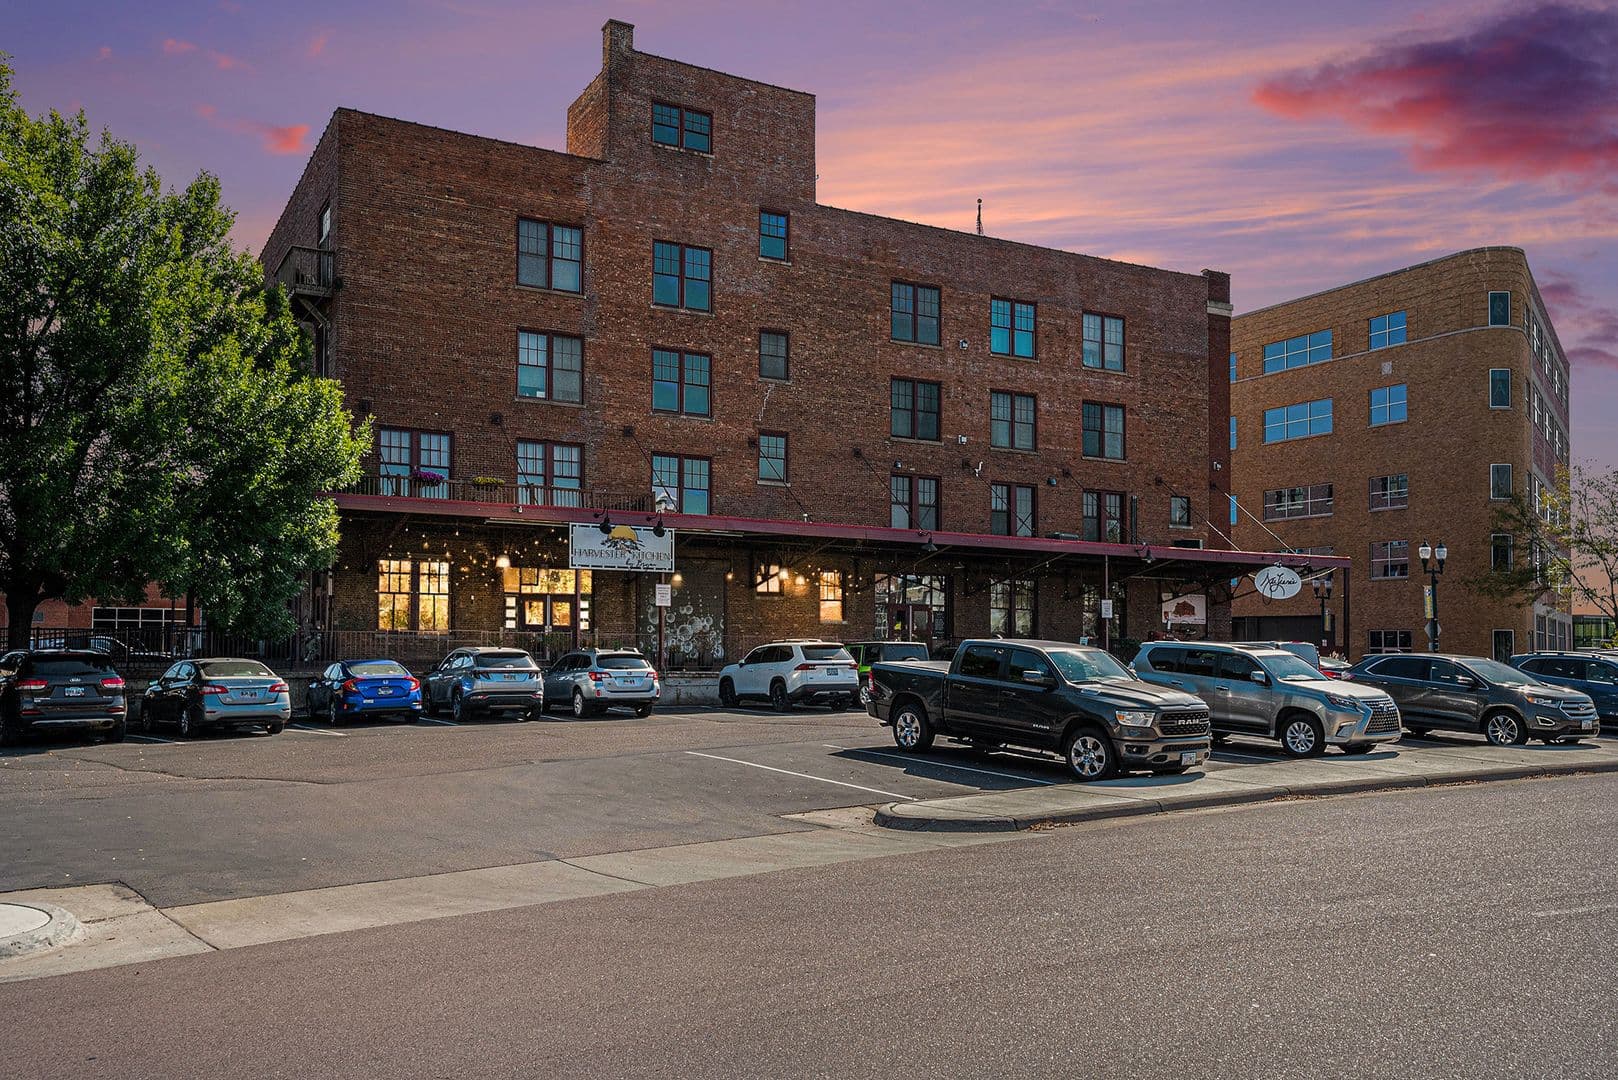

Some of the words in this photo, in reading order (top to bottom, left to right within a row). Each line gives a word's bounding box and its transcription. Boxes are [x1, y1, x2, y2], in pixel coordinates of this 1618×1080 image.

[574, 548, 627, 559] HARVESTER
[632, 552, 671, 561] KITCHEN
[1178, 718, 1199, 726] RAM
